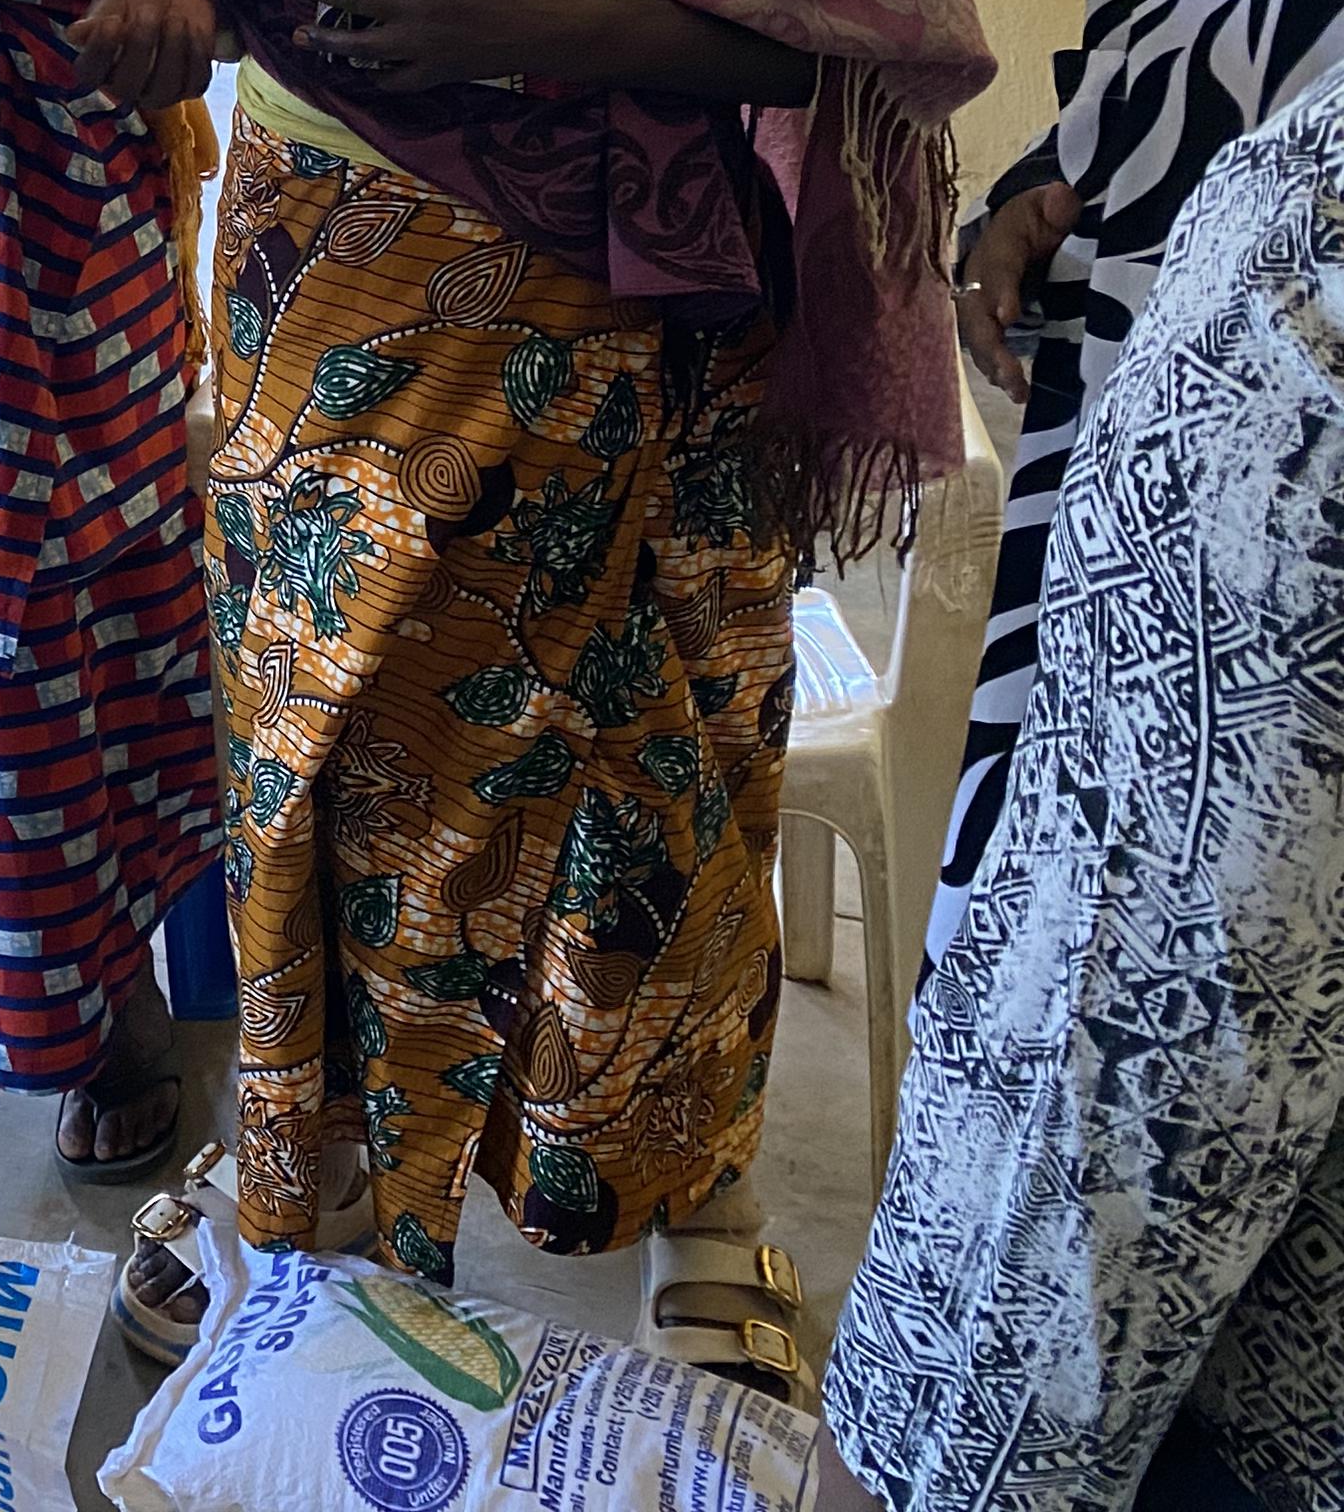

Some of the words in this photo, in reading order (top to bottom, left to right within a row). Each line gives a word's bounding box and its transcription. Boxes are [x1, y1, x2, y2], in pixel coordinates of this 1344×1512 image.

[345, 1404, 381, 1478] Registered
[408, 1474, 448, 1505] Under
[377, 1417, 425, 1480] 005
[505, 1390, 545, 1468] MAIZE
[543, 1373, 584, 1511] Manufactured
[575, 1424, 597, 1481] Rwanda
[594, 1411, 625, 1486] Contact:
